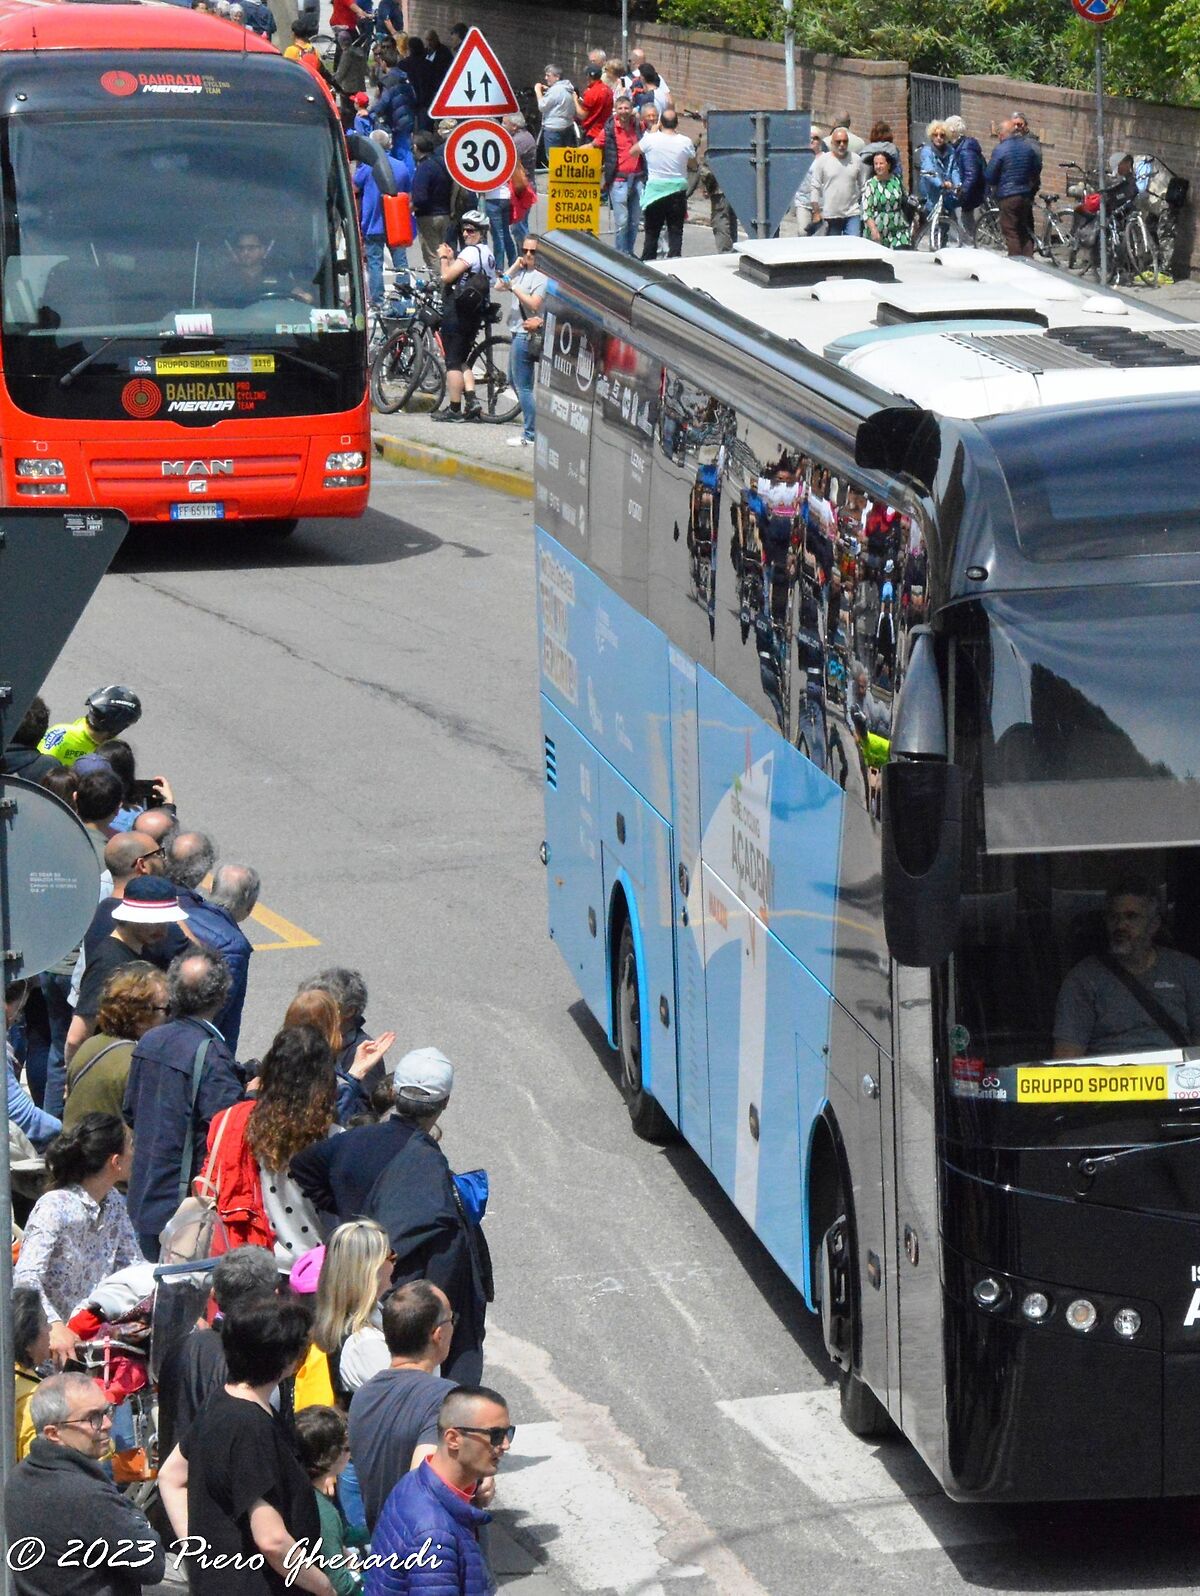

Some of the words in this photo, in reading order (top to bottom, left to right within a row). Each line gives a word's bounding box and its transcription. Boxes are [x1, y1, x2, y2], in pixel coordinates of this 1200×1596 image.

[138, 73, 202, 85] BAHRAIN
[142, 84, 203, 93] MERIDA
[461, 140, 501, 172] 30
[563, 150, 589, 163] Giro
[555, 165, 595, 178] d'Italia
[551, 188, 598, 199] 21/05/2019
[555, 202, 593, 212] STRADA
[555, 214, 592, 224] CHIUSA
[157, 360, 188, 369] GRUPPO
[190, 359, 228, 368] SPORTIVO
[166, 382, 235, 400] BAHRAIN
[236, 391, 267, 400] CYCLING
[168, 400, 235, 412] MERIDA
[237, 401, 255, 410] TEAM
[162, 460, 234, 475] MAN
[1020, 1077, 1084, 1093] GRUPPO
[1088, 1075, 1166, 1092] SPORTIVO
